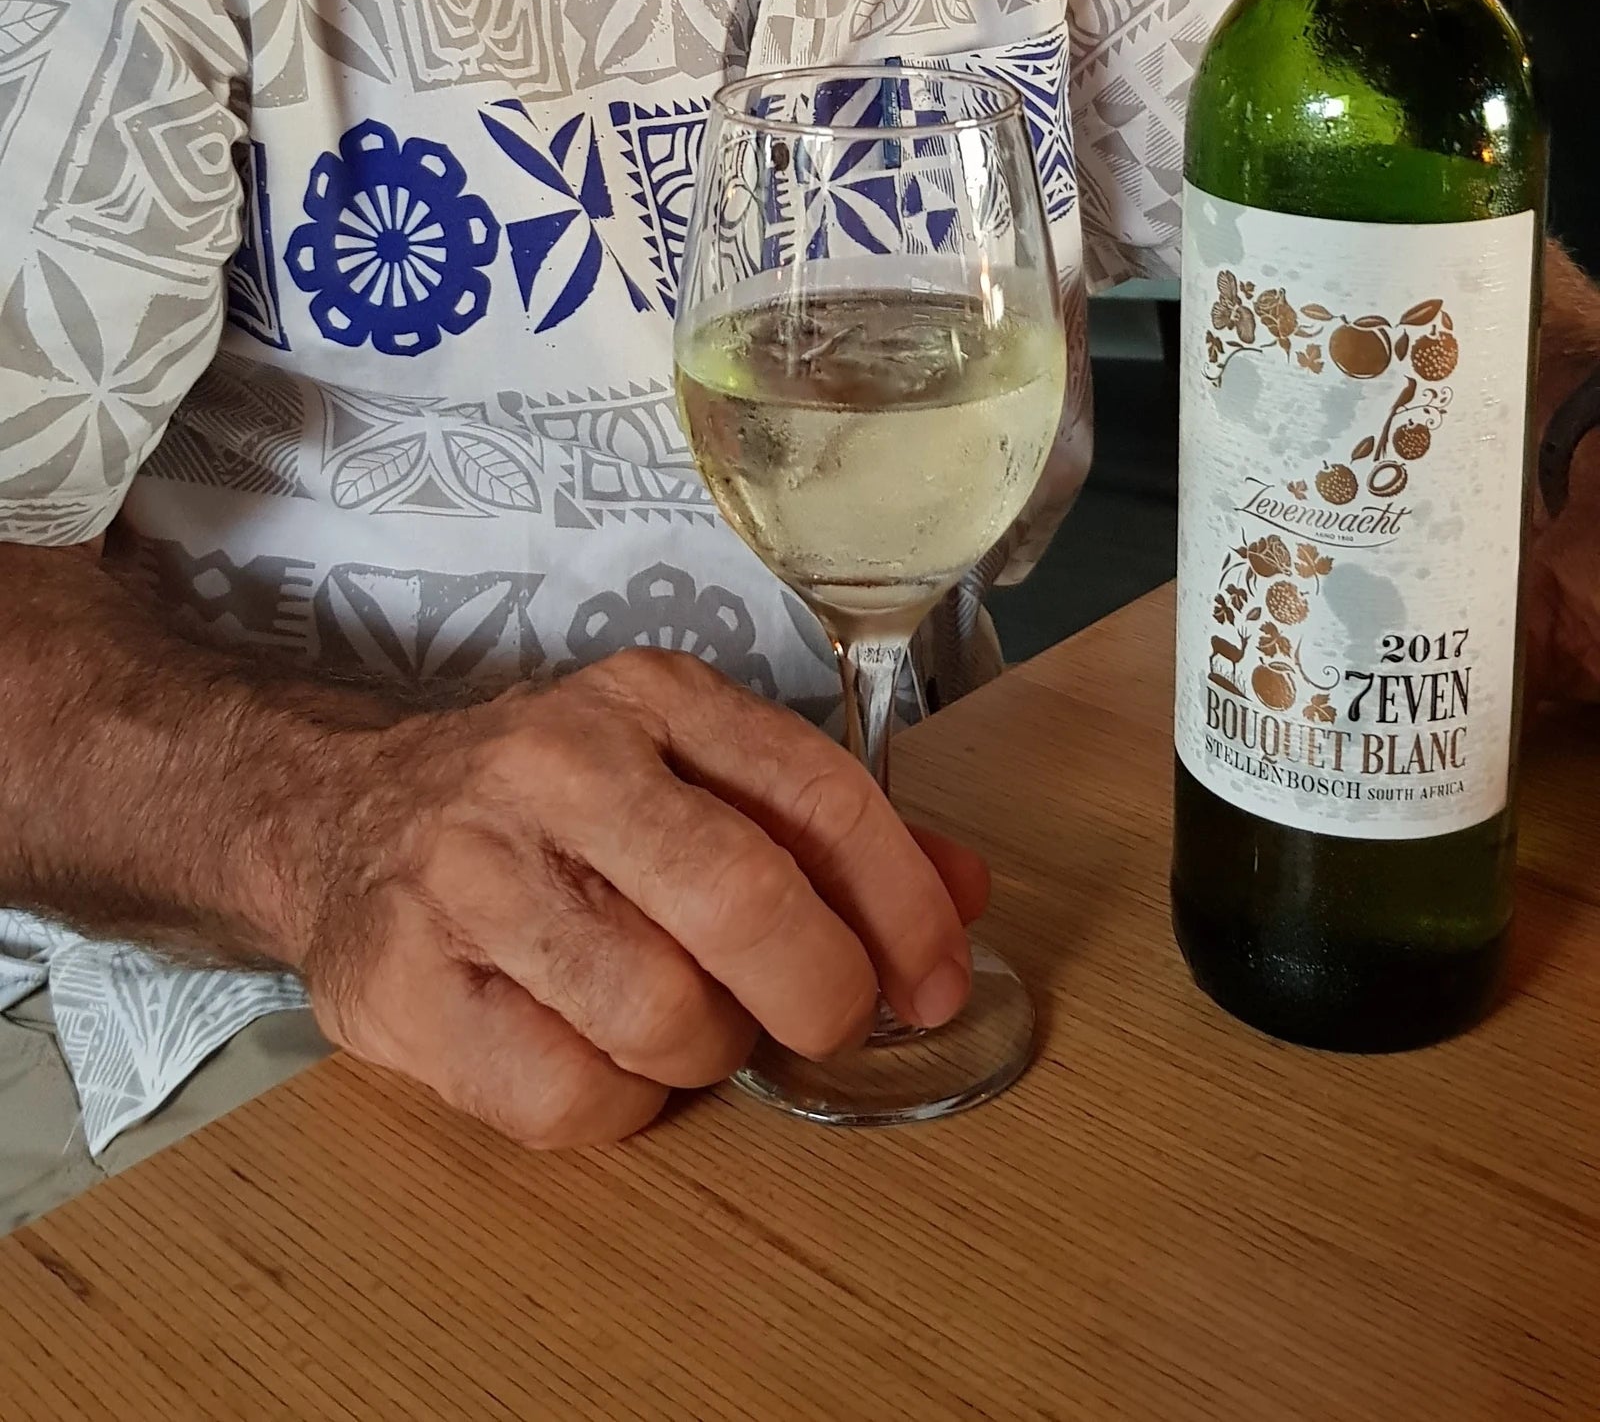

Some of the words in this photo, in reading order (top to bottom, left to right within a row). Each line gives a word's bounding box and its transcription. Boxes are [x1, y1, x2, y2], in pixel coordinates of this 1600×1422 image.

[1234, 477, 1412, 548] Zevenwacht
[1381, 628, 1470, 663] 2017
[1345, 667, 1472, 724] 7EVEN
[1206, 686, 1352, 772] BOUQUET
[1360, 726, 1468, 775] BLANC
[1205, 735, 1361, 800] STELLENBOSCH
[1367, 787, 1414, 801] SOUTH
[1419, 780, 1465, 800] AFRICA
